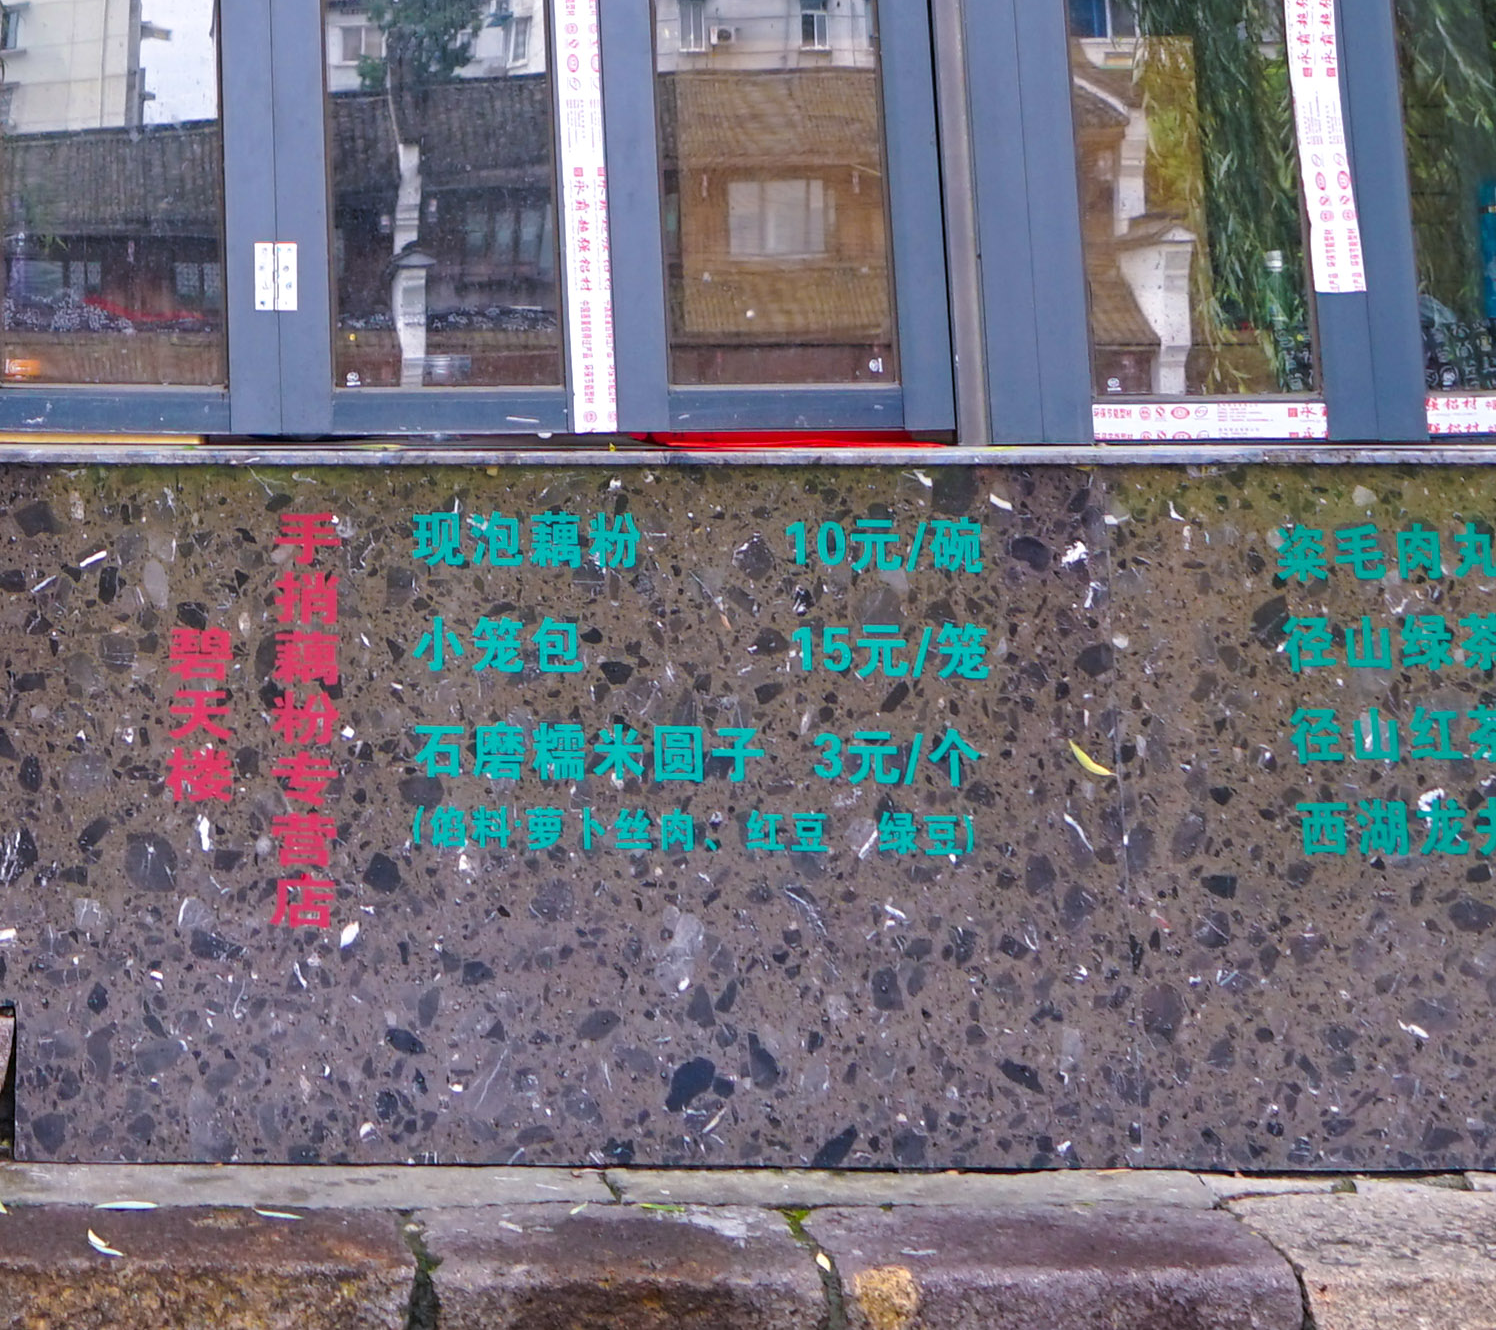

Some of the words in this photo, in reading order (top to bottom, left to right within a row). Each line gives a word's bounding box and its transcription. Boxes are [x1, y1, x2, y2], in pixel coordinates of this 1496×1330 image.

[413, 512, 642, 570] 现泡藕粉
[787, 518, 985, 574] 10元/碗
[414, 617, 584, 674] 小笼包
[793, 624, 990, 680] 15元/笼
[167, 628, 234, 803] 碧天楼
[271, 514, 341, 929] 手捎藕粉专营店
[415, 723, 766, 783] 石磨糯米圆子
[815, 730, 981, 787] 3元/个
